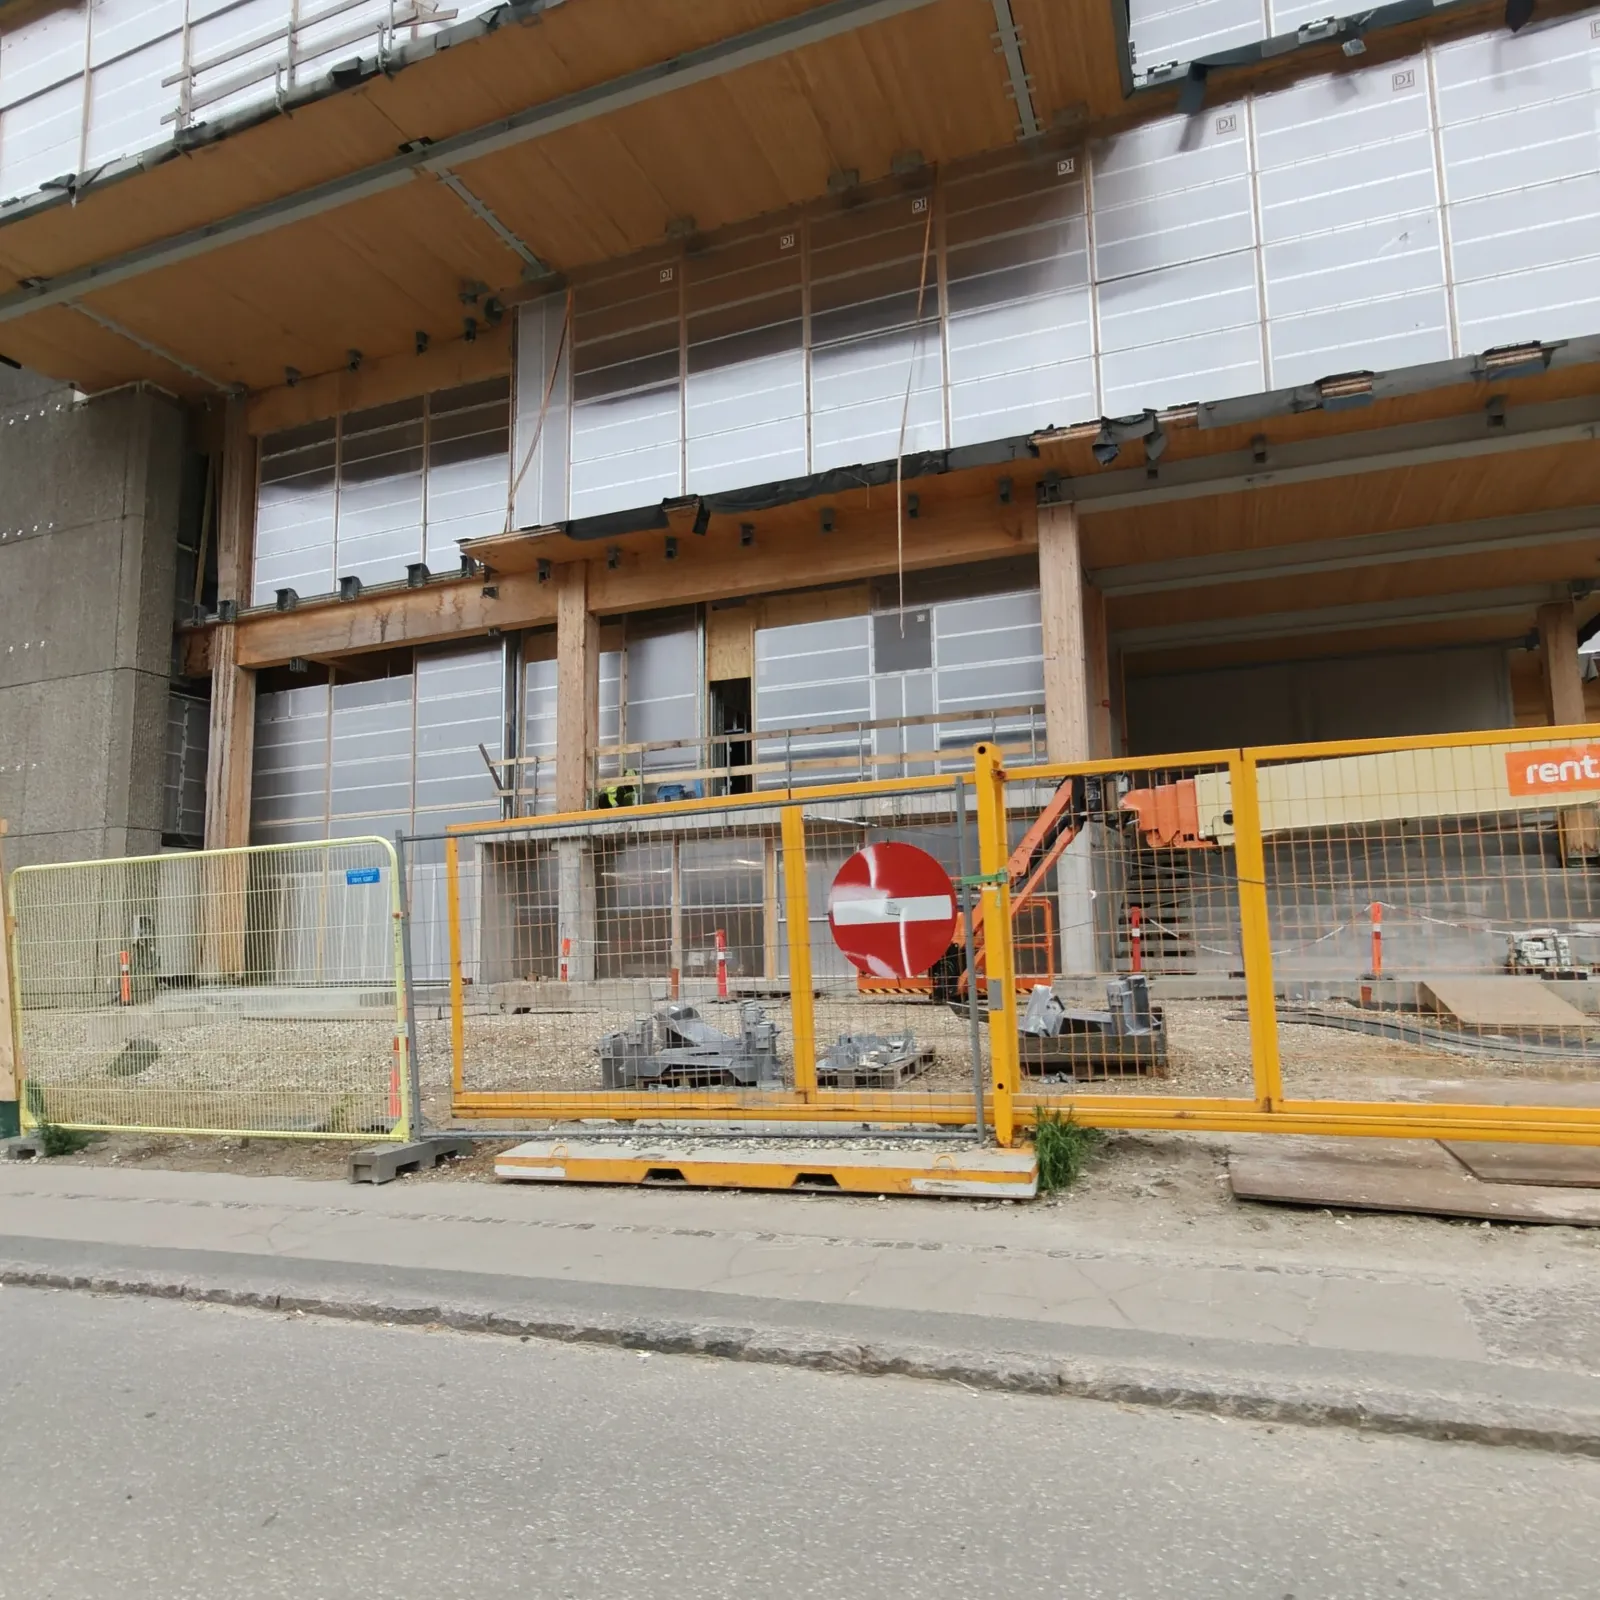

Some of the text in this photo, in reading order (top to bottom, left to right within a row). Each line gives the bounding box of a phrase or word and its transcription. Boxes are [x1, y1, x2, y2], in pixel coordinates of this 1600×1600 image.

[1395, 72, 1411, 85] DI
[1219, 117, 1233, 130] DI
[1059, 160, 1071, 171] DI
[913, 199, 925, 209] DI
